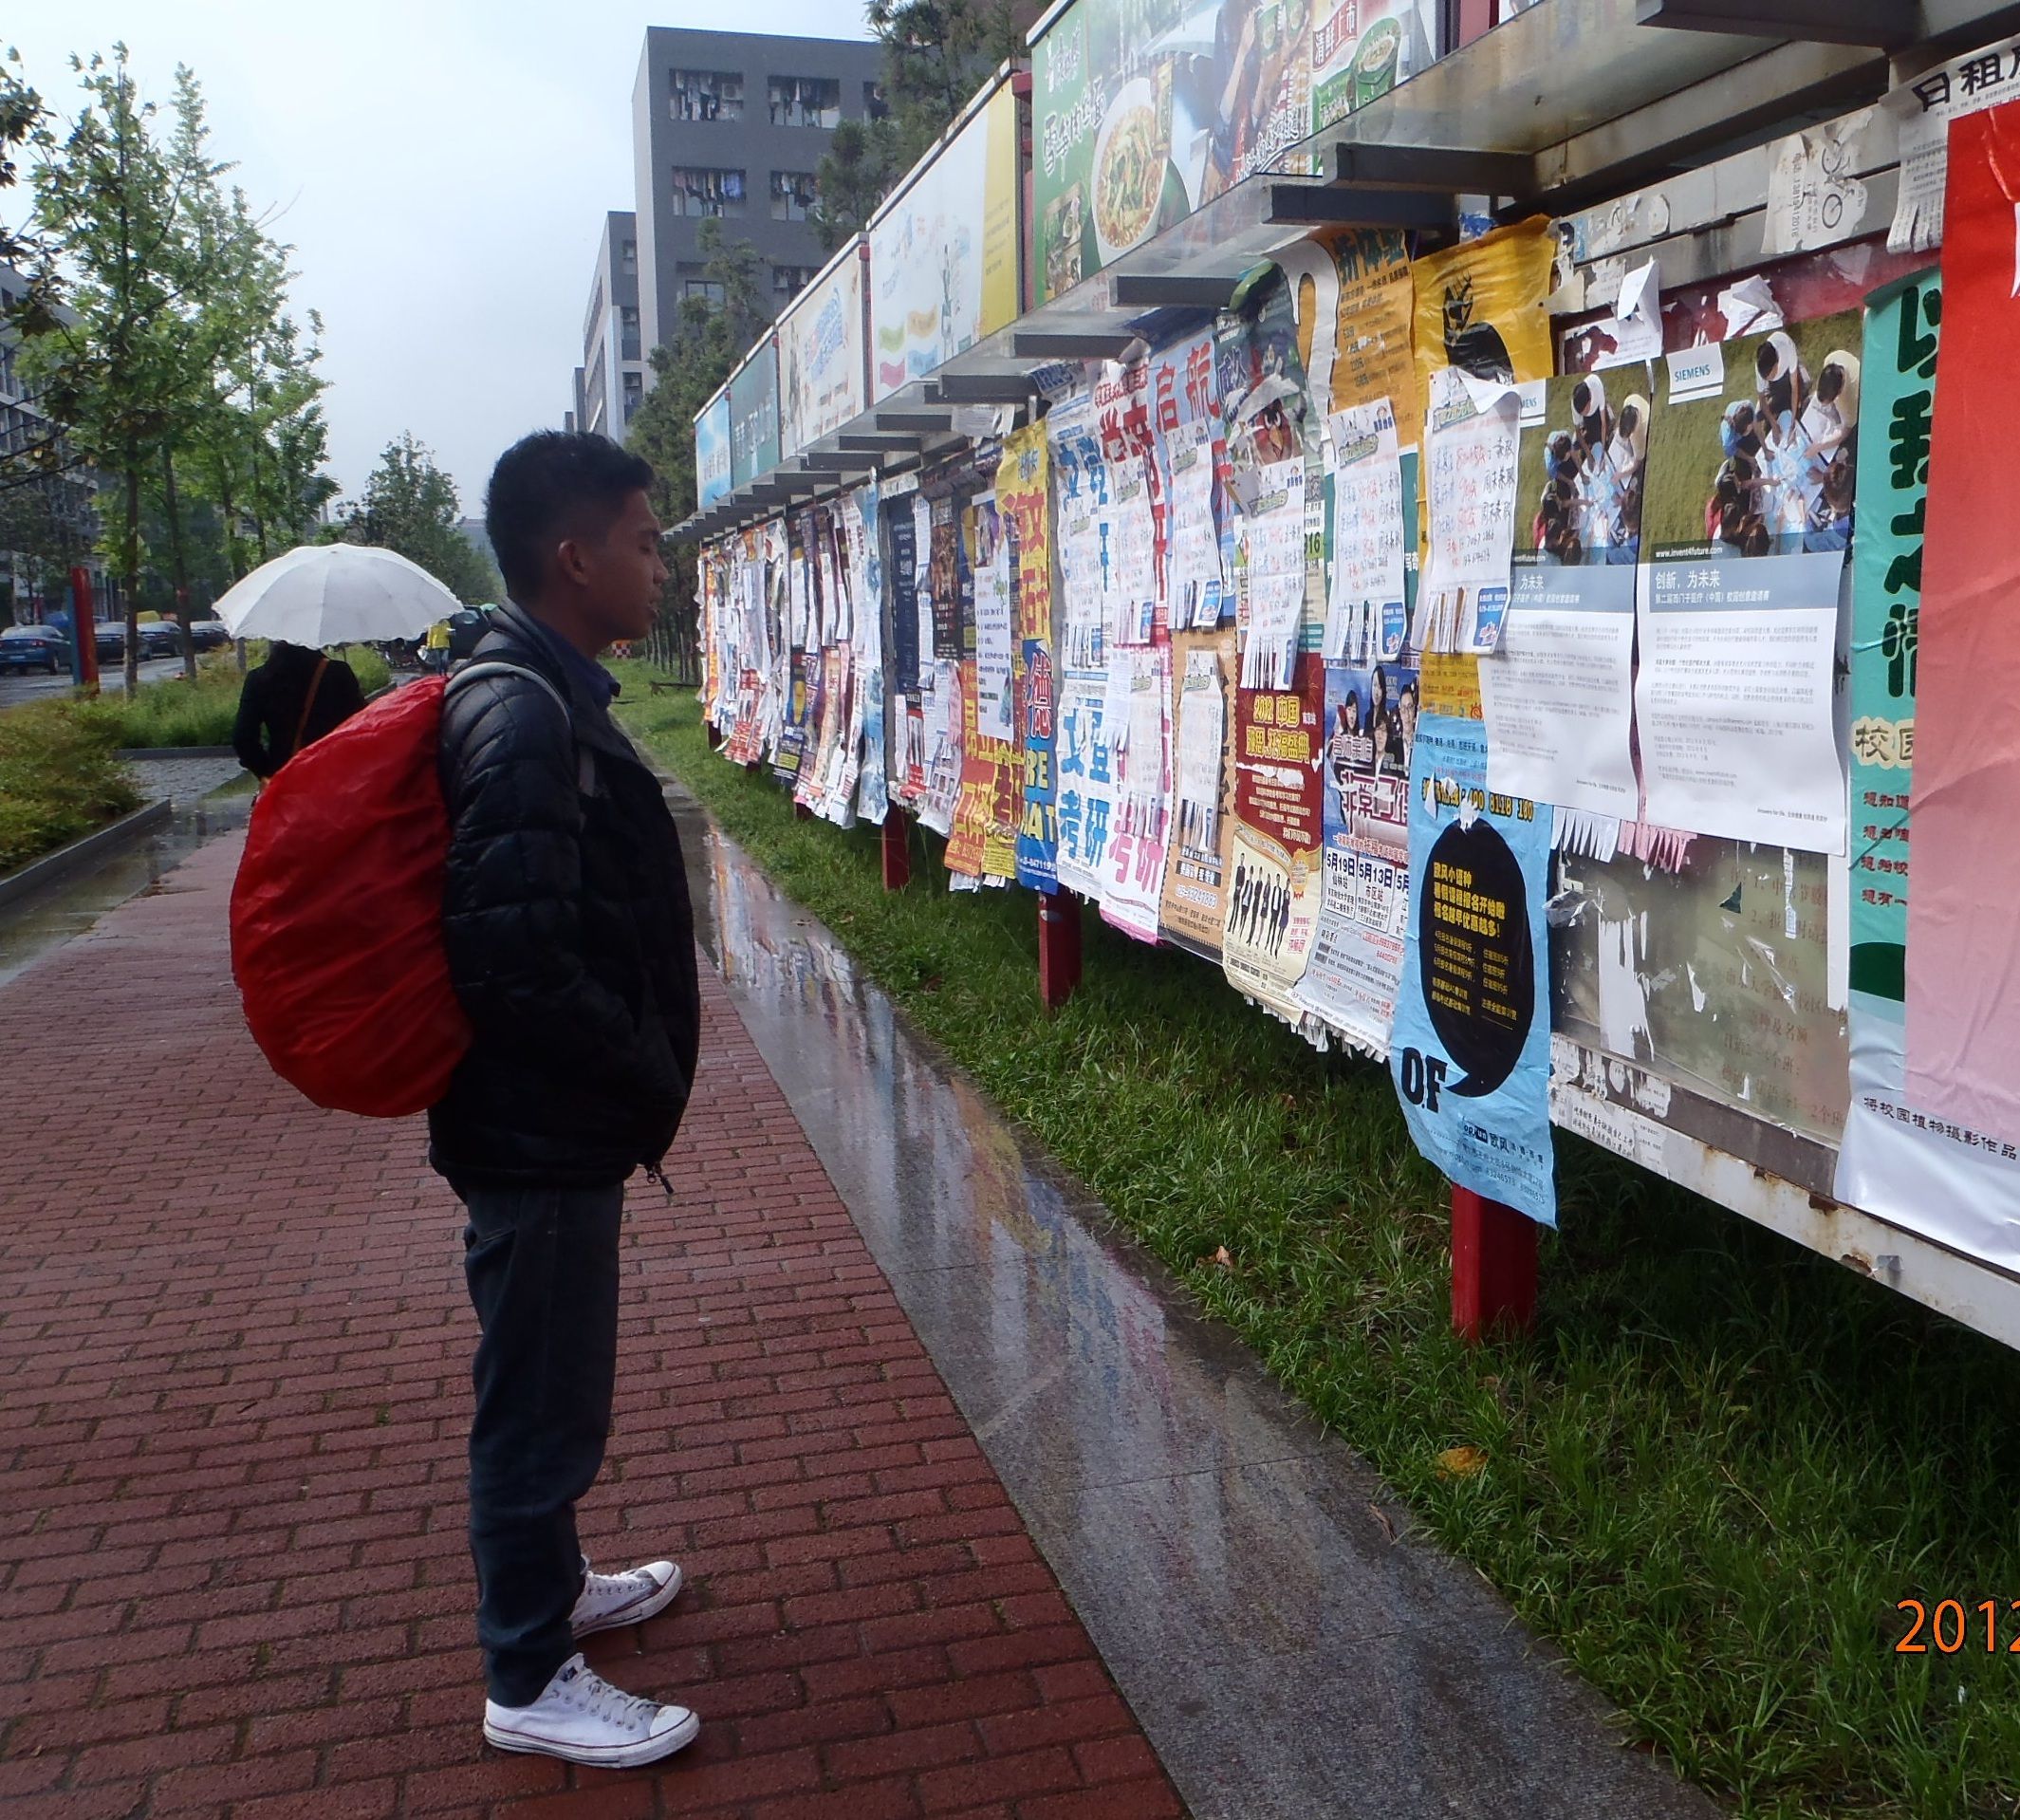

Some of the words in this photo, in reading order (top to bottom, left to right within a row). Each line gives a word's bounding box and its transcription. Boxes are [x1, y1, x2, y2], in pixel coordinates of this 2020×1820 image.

[1674, 364, 1711, 382] SIEMENS
[1326, 852, 1355, 878] 5月19日
[1359, 862, 1393, 889] 5月13日
[1863, 1097, 2017, 1161] 将校园植物摄影作品
